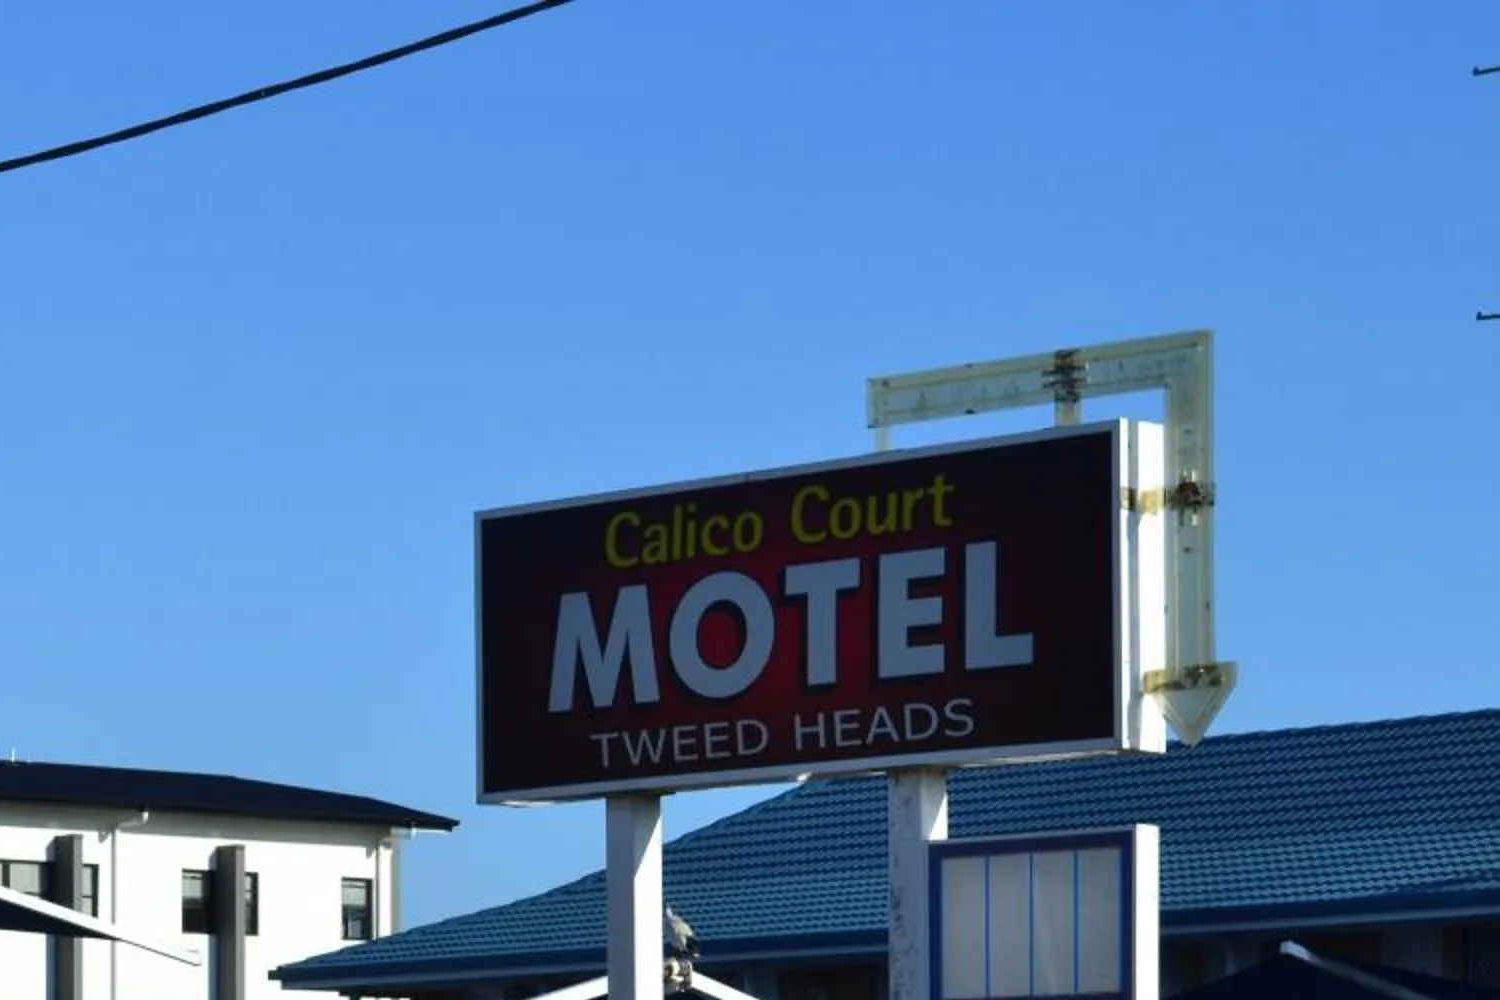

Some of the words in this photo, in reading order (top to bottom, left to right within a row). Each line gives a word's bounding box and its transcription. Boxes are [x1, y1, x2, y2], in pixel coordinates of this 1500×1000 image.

[606, 504, 762, 568] Calico
[791, 474, 955, 543] Court
[548, 541, 1034, 713] MOTEL
[591, 720, 769, 769] TWEED
[794, 699, 975, 751] HEADS
